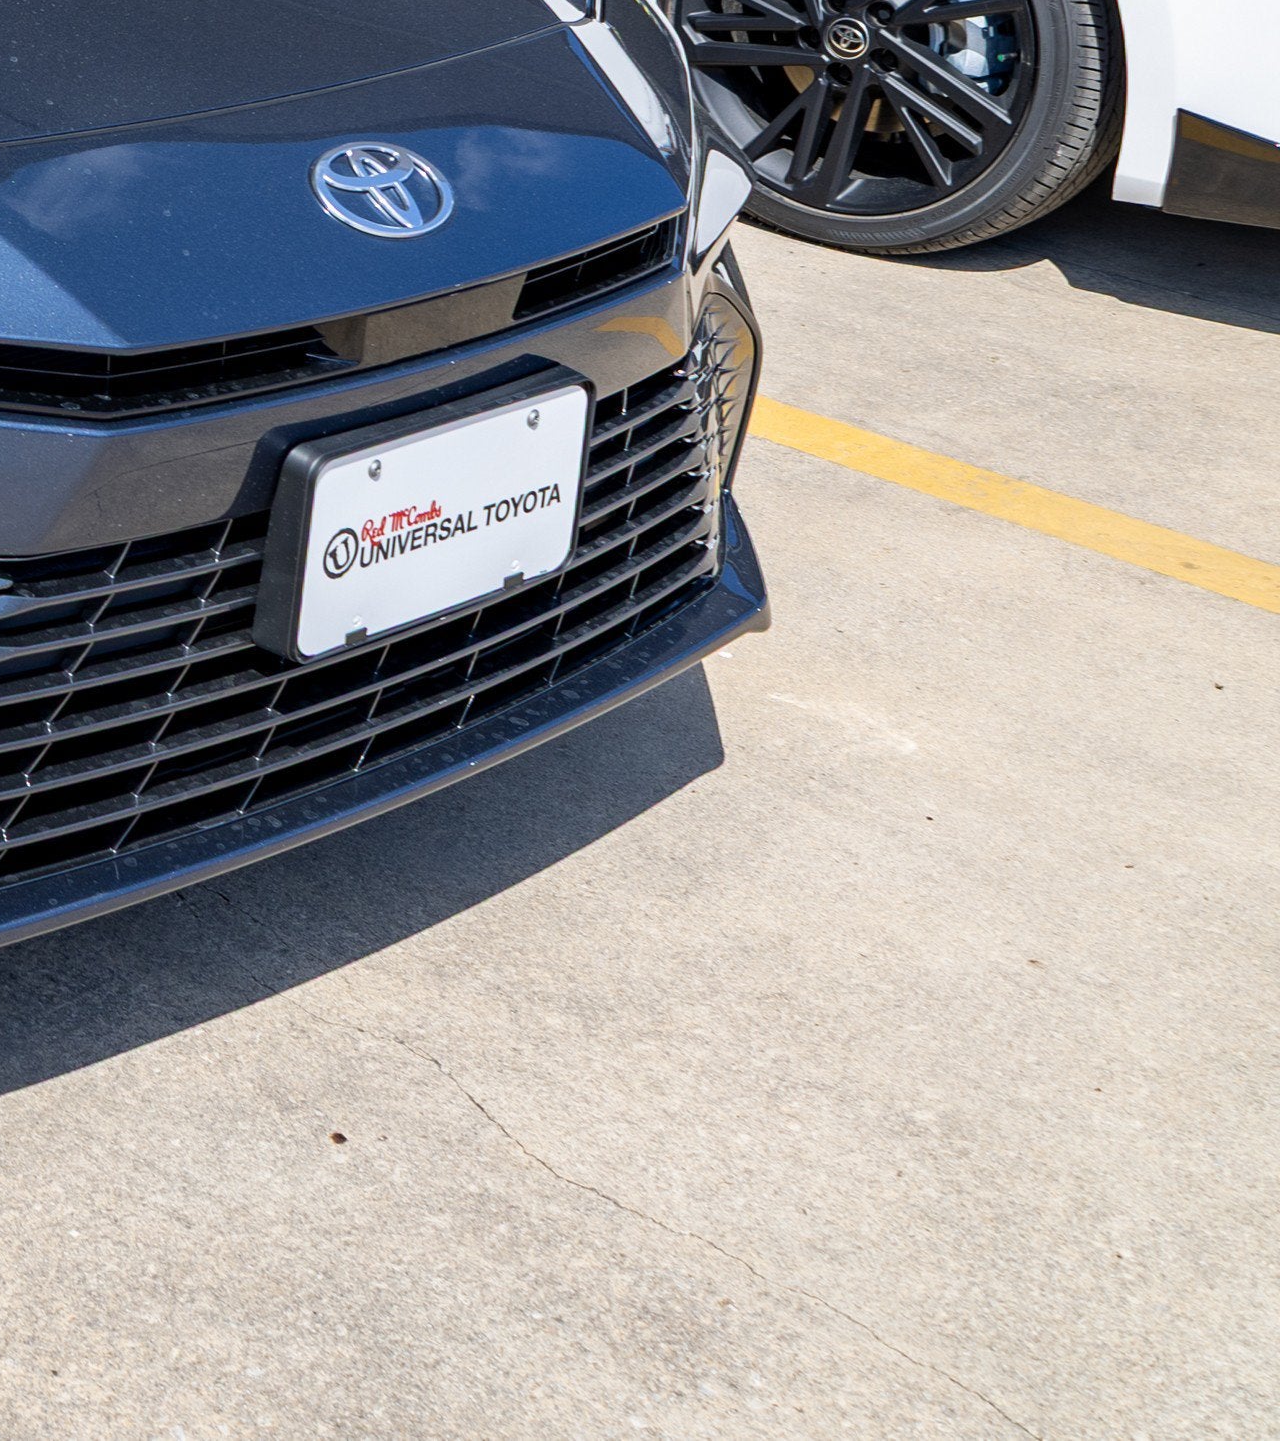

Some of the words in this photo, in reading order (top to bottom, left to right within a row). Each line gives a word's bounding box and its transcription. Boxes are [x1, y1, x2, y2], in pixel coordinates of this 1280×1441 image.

[359, 510, 478, 568] UNIVERSAL
[483, 482, 561, 527] TOYOTA
[361, 515, 388, 546] Red
[389, 500, 442, 533] McCombs
